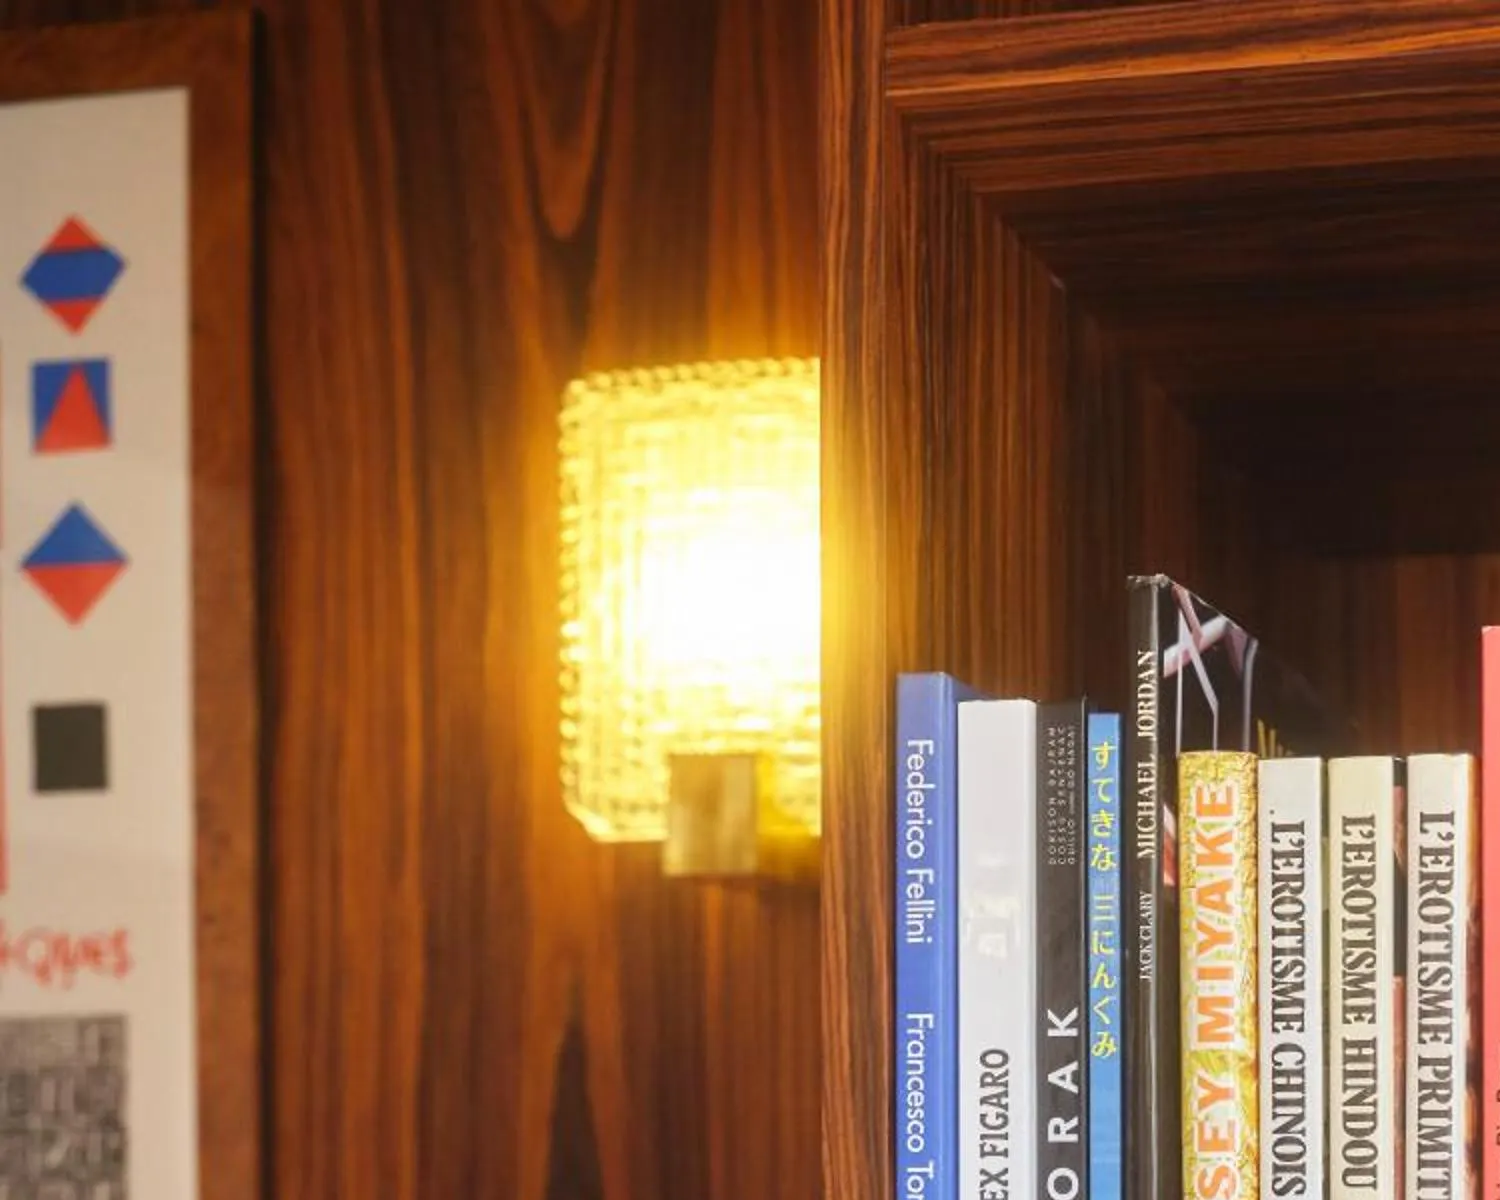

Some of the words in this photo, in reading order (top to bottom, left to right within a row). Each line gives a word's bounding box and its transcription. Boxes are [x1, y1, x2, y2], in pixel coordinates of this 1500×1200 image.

[1137, 649, 1157, 742] JORDAN
[907, 739, 934, 859] Federico
[1137, 754, 1157, 860] MICHAEL
[907, 868, 936, 944] Fellini
[1138, 891, 1153, 941] CLARY
[1198, 781, 1237, 1045] MIYAKE
[1138, 943, 1153, 983] JACK
[907, 1013, 934, 1153] Francesco
[979, 1049, 1009, 1158] FIGARO
[1270, 1043, 1307, 1197] CHINOIS
[1341, 1037, 1377, 1191] HINDOU
